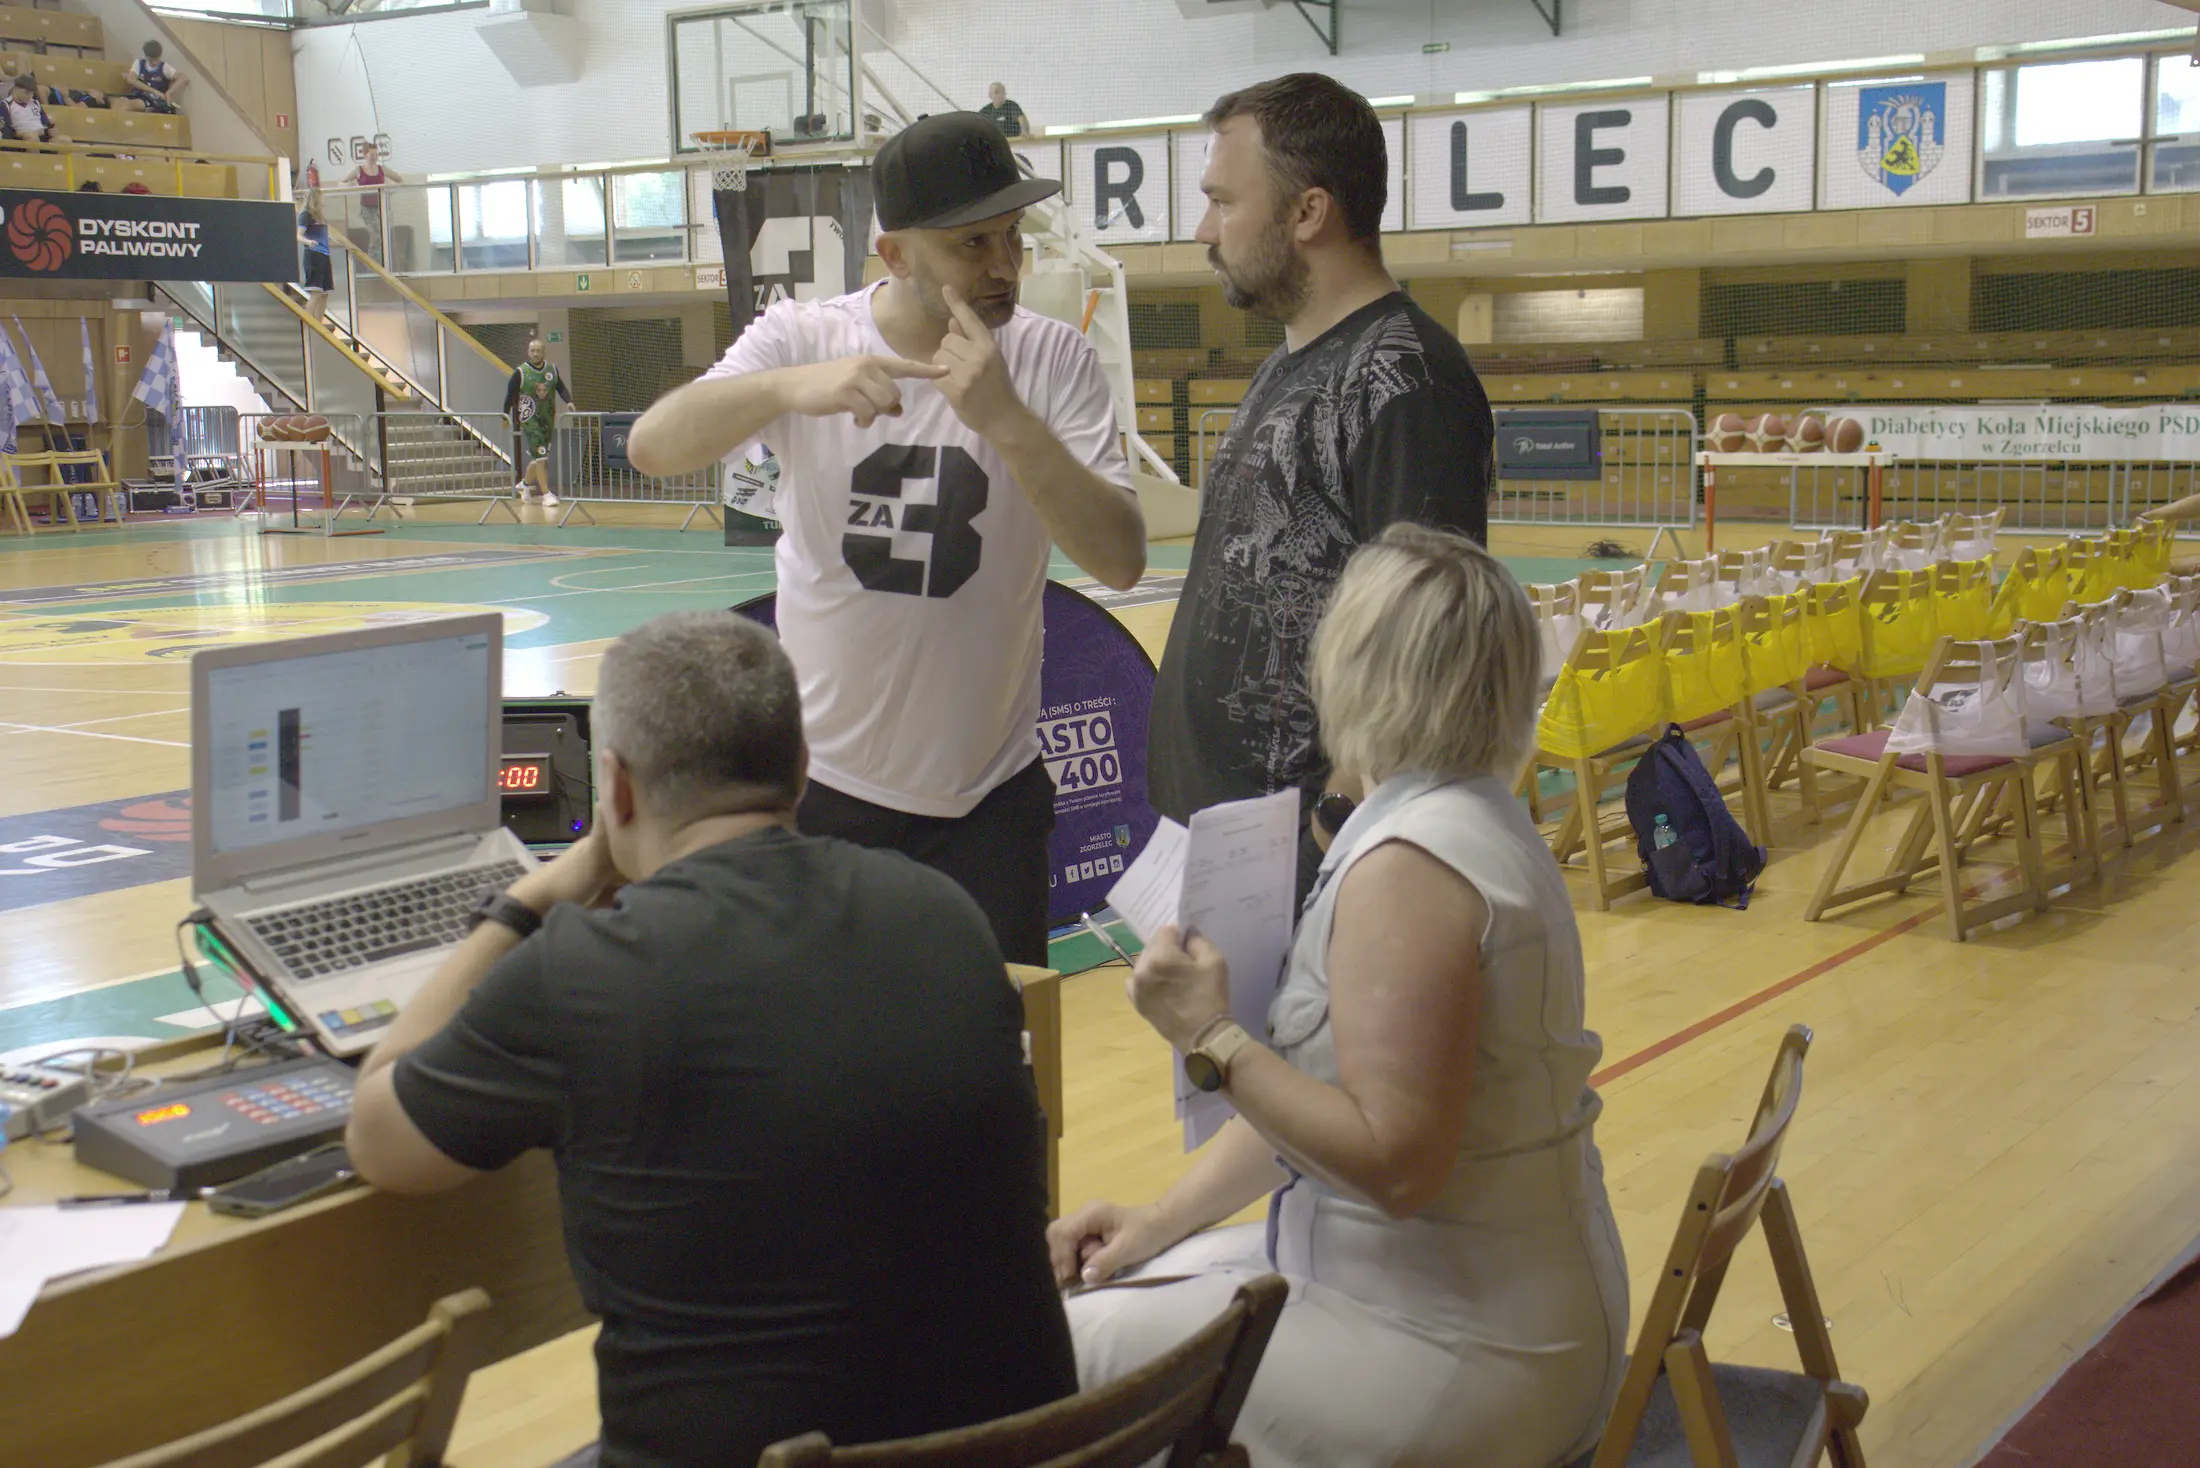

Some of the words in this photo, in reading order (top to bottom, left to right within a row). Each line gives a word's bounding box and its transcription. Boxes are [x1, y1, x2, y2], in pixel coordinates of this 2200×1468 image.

[78, 218, 201, 239] DYSKONT
[2026, 215, 2069, 230] SEKTOR
[2073, 210, 2089, 232] 5
[80, 239, 202, 258] PALIWOWY
[697, 273, 719, 284] SEKTOR
[1872, 416, 1969, 439] Diabetycy
[1978, 416, 2026, 435] Koła
[2034, 415, 2150, 438] Miejskiego
[1982, 442, 1993, 453] w
[2001, 439, 2081, 456] Zgorzelcu
[847, 500, 895, 530] ZA
[1049, 703, 1073, 718] (SMS)
[1074, 702, 1081, 711] O
[1036, 716, 1112, 755] ASTO
[1060, 753, 1118, 789] 400
[1080, 840, 1113, 853] ZGORZELEC
[1089, 832, 1112, 842] MIASTO
[1049, 874, 1058, 888] U
